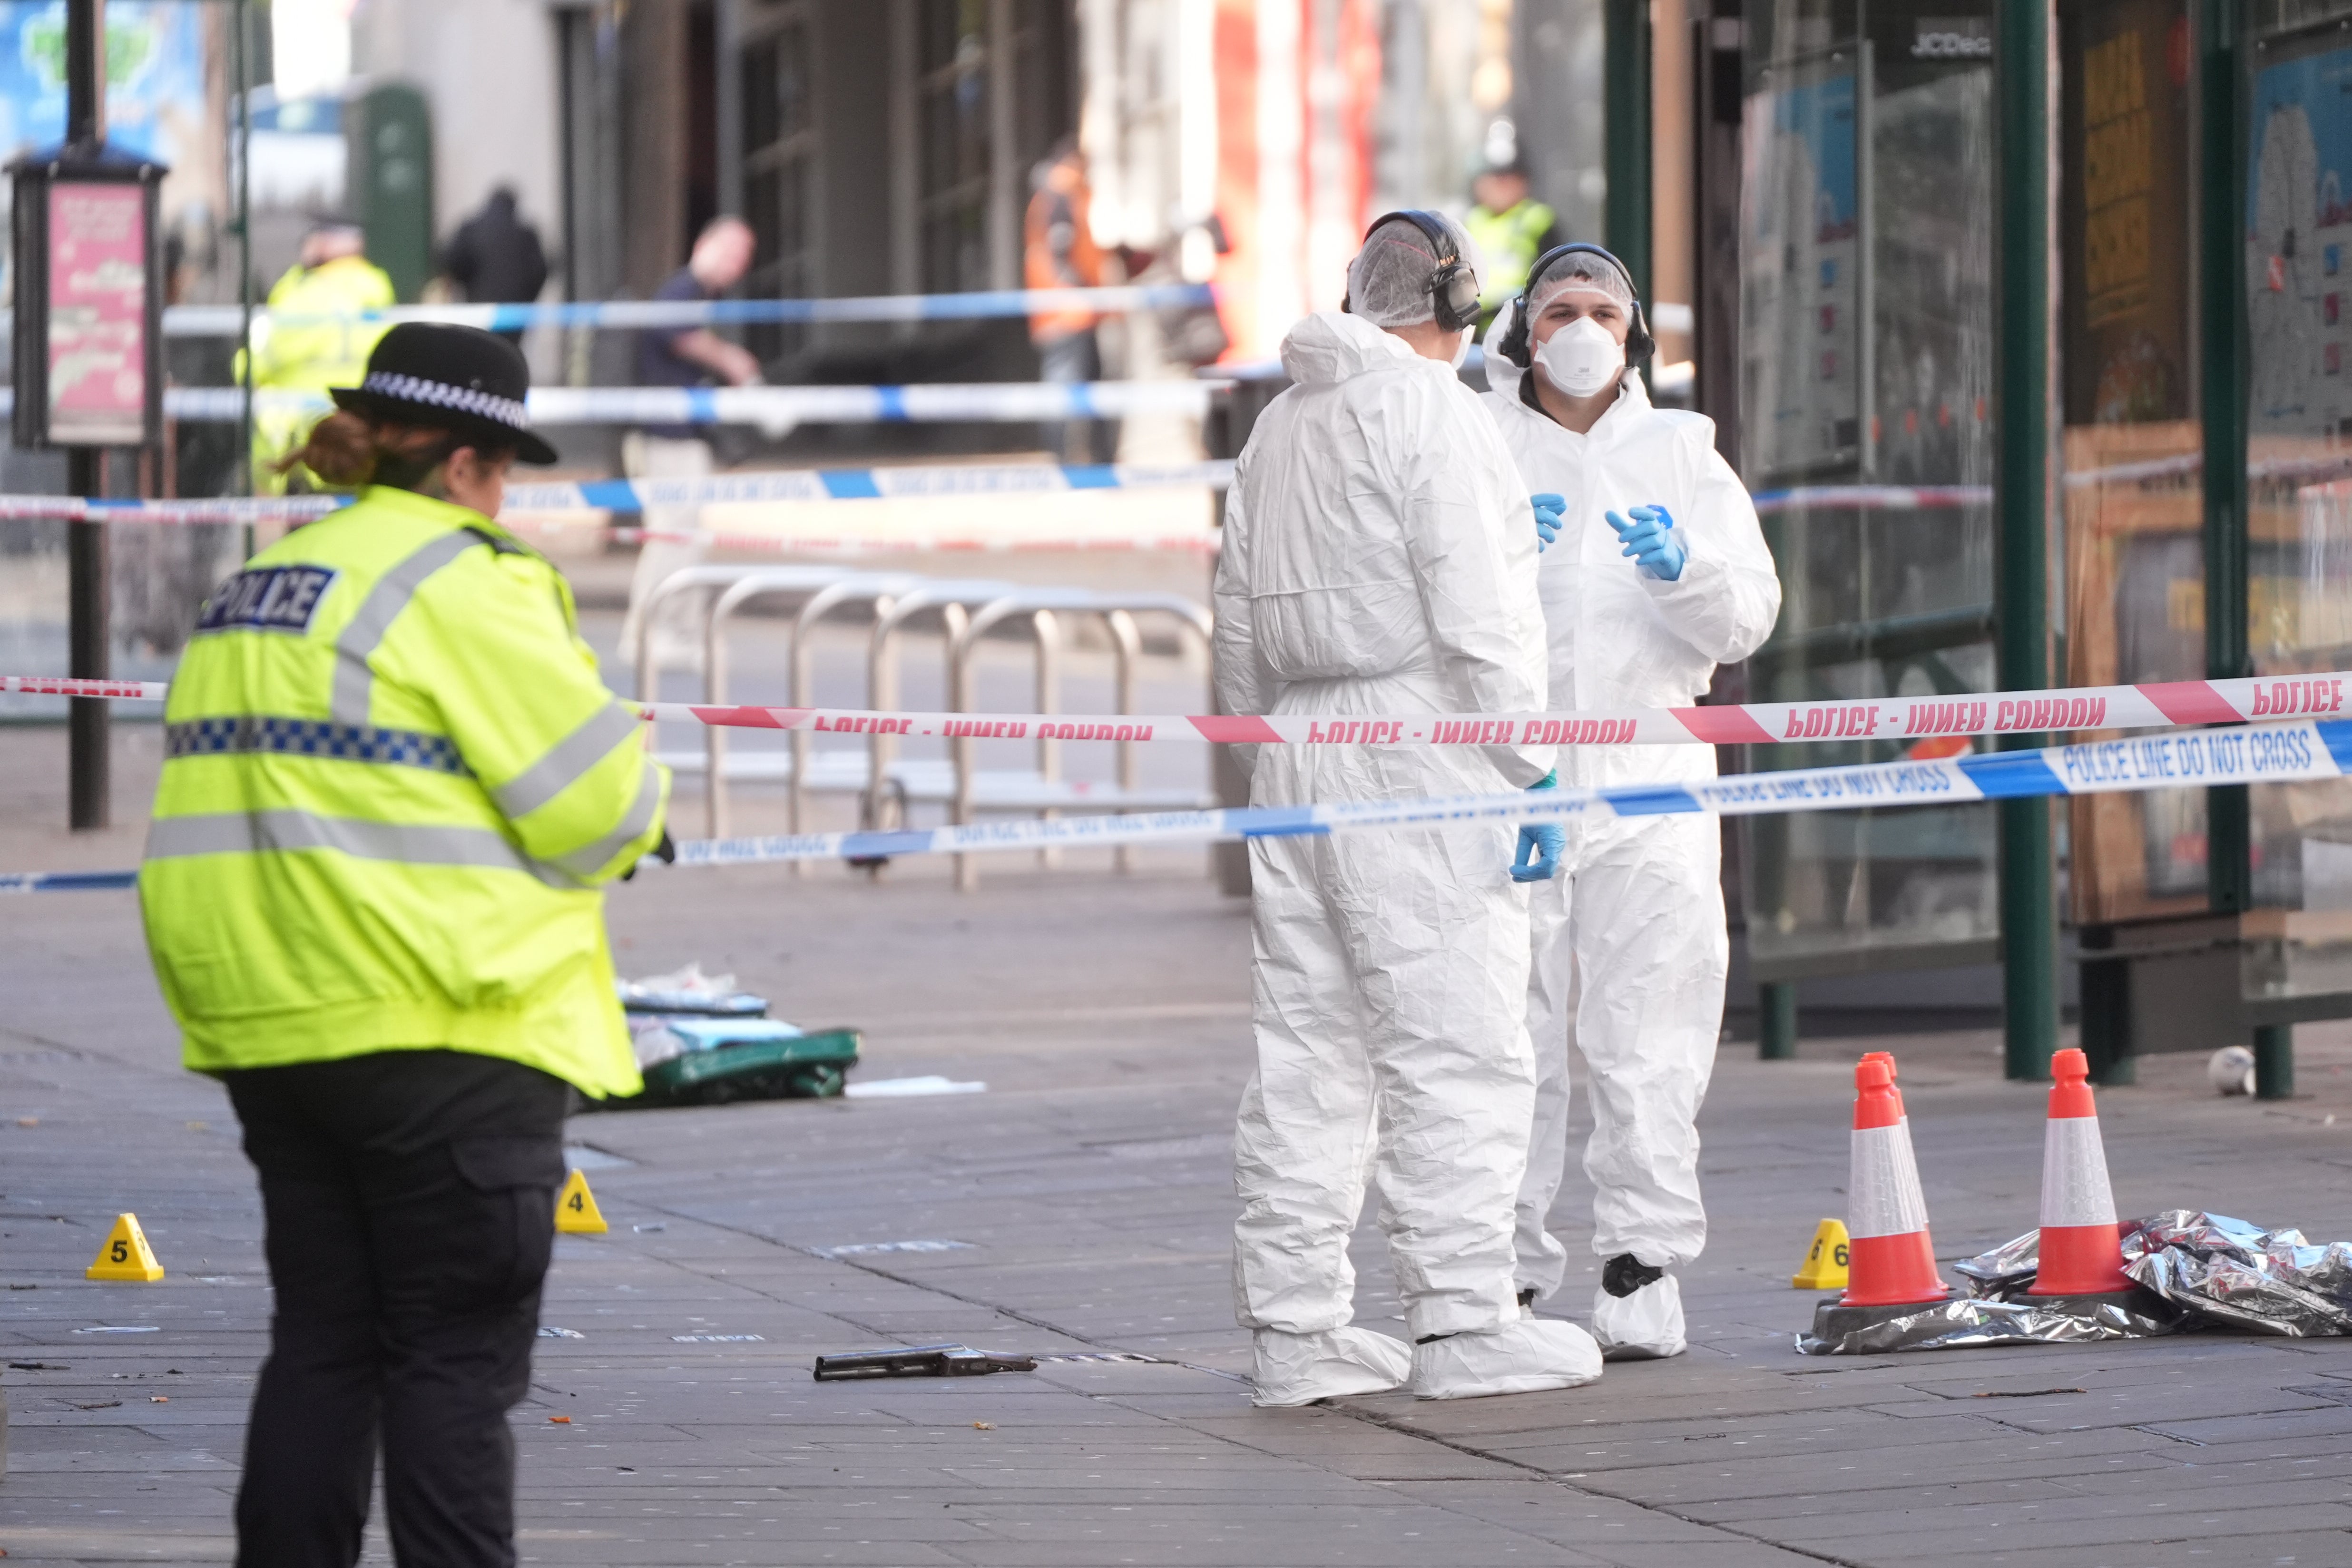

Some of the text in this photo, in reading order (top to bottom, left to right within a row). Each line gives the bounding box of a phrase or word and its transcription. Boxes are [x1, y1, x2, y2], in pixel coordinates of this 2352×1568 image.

[200, 570, 325, 621] POLICE
[2064, 728, 2312, 783] POLICE LINE DO NOT CROSS
[568, 1192, 583, 1211] 4
[111, 1240, 127, 1263] 5
[1834, 1244, 1849, 1266] 6
